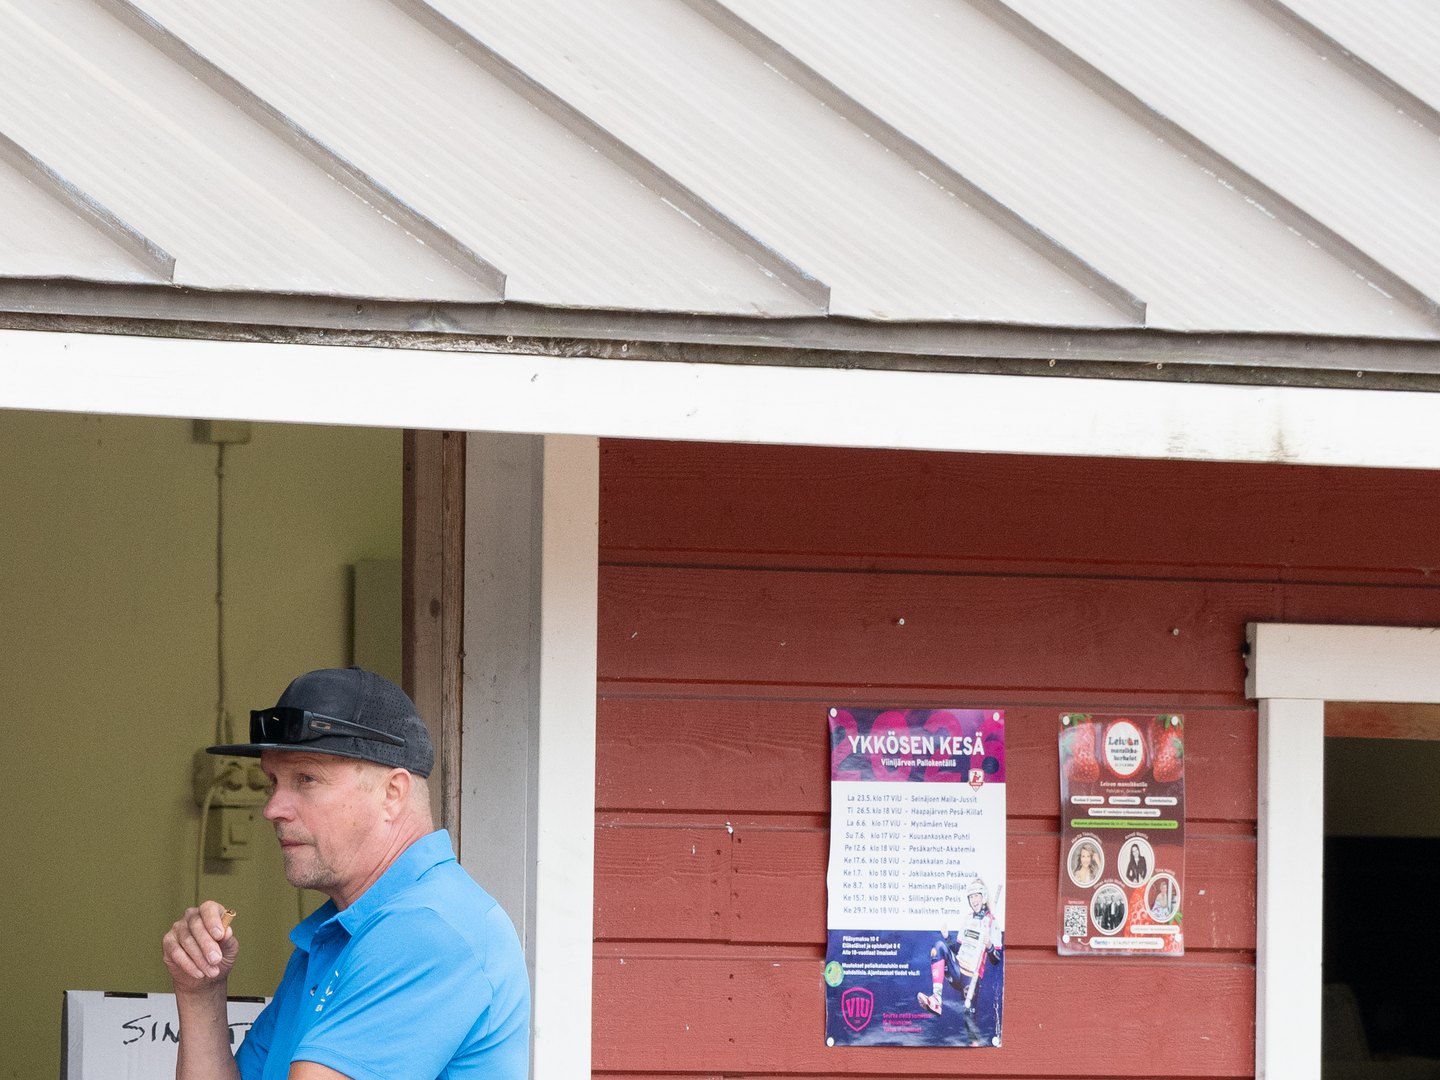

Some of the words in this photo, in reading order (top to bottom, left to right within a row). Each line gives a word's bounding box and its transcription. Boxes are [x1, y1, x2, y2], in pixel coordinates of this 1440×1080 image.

[848, 730, 935, 755] YKKÖSEN
[940, 732, 985, 756] KESÄ
[881, 758, 916, 768] Viinijärven
[916, 758, 957, 767] Pallokentällä
[911, 795, 940, 803] Seinäjoen
[911, 808, 948, 816] Haapajärven
[910, 820, 943, 829] Mynämäen
[908, 845, 976, 853] Pesäkarhut-Akatemia
[946, 870, 978, 878] Pesäkuula
[937, 883, 967, 892] Palloilijat
[908, 896, 944, 904] Siilinjärven
